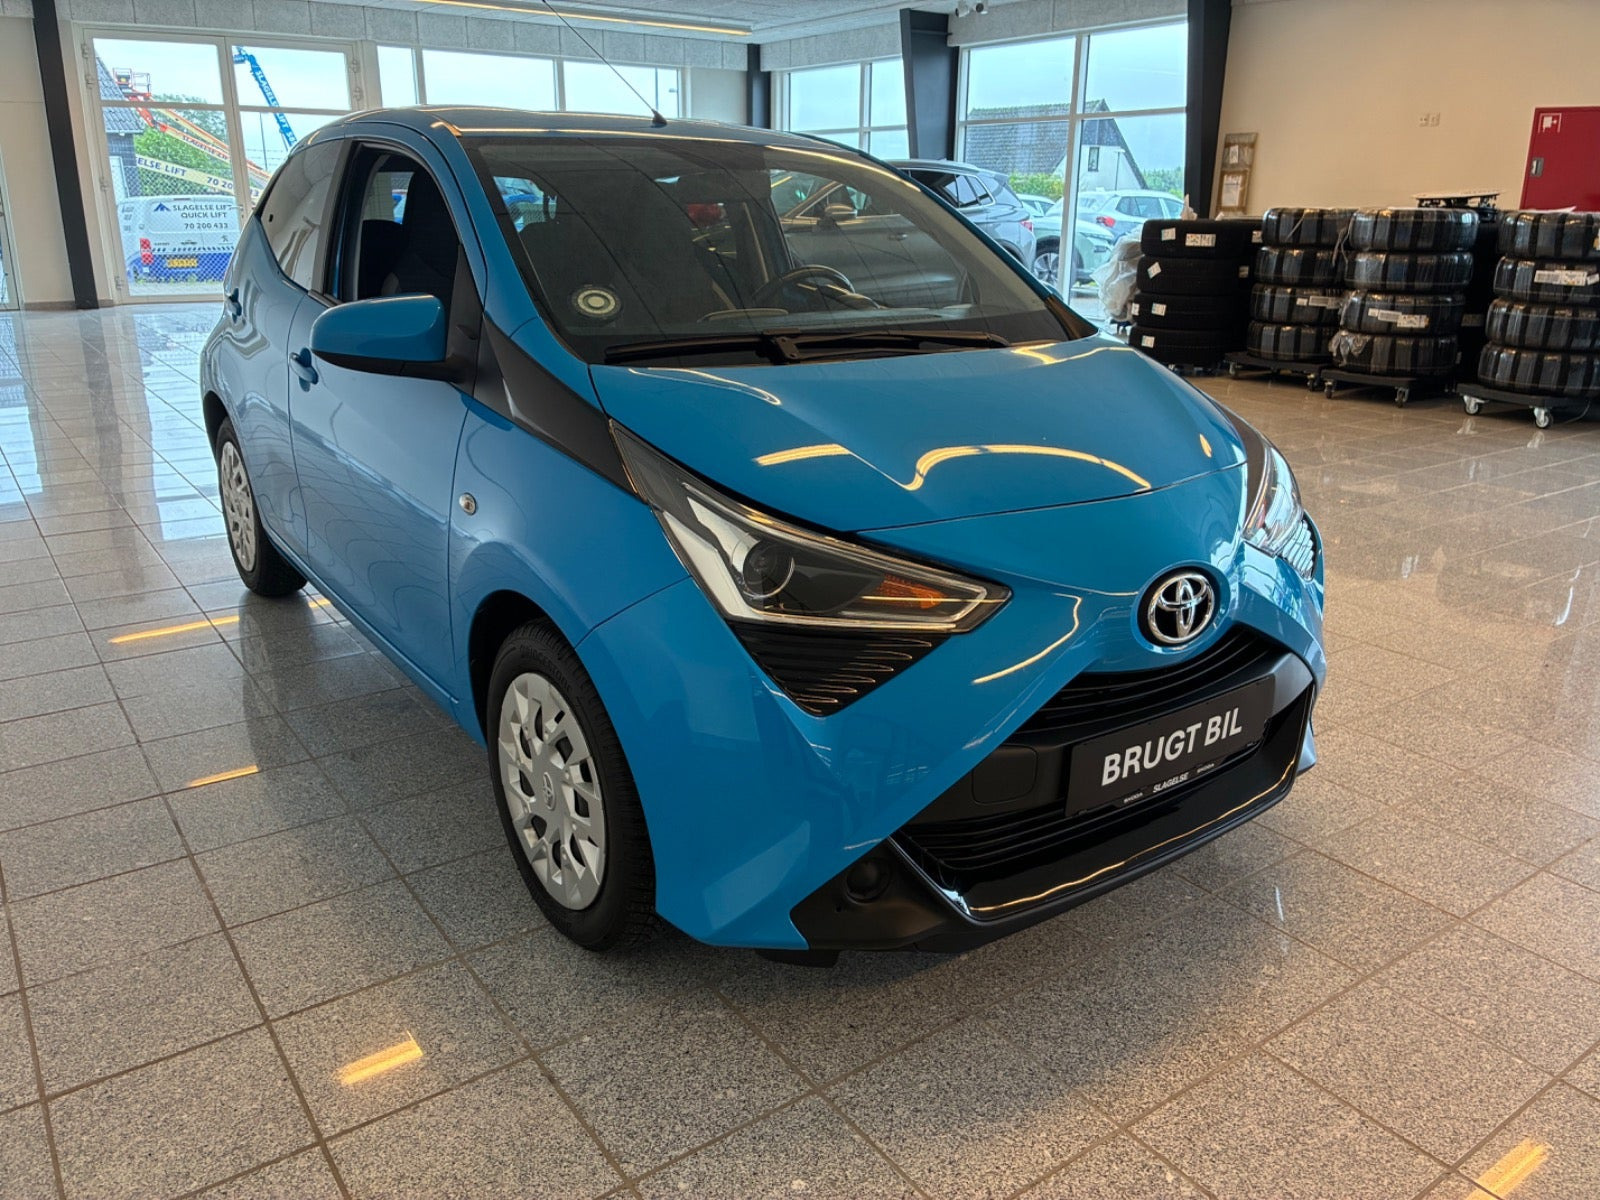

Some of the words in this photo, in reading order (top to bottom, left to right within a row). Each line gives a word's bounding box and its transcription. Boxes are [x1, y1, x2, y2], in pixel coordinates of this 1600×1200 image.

[255, 71, 279, 107] SLAGELS
[137, 157, 161, 170] ELSE
[164, 165, 187, 176] LIFT
[207, 176, 219, 186] 70
[221, 181, 233, 190] 20
[1101, 722, 1202, 786] BRUGT
[1204, 707, 1242, 746] BIL
[1153, 772, 1189, 793] SLAGELSE
